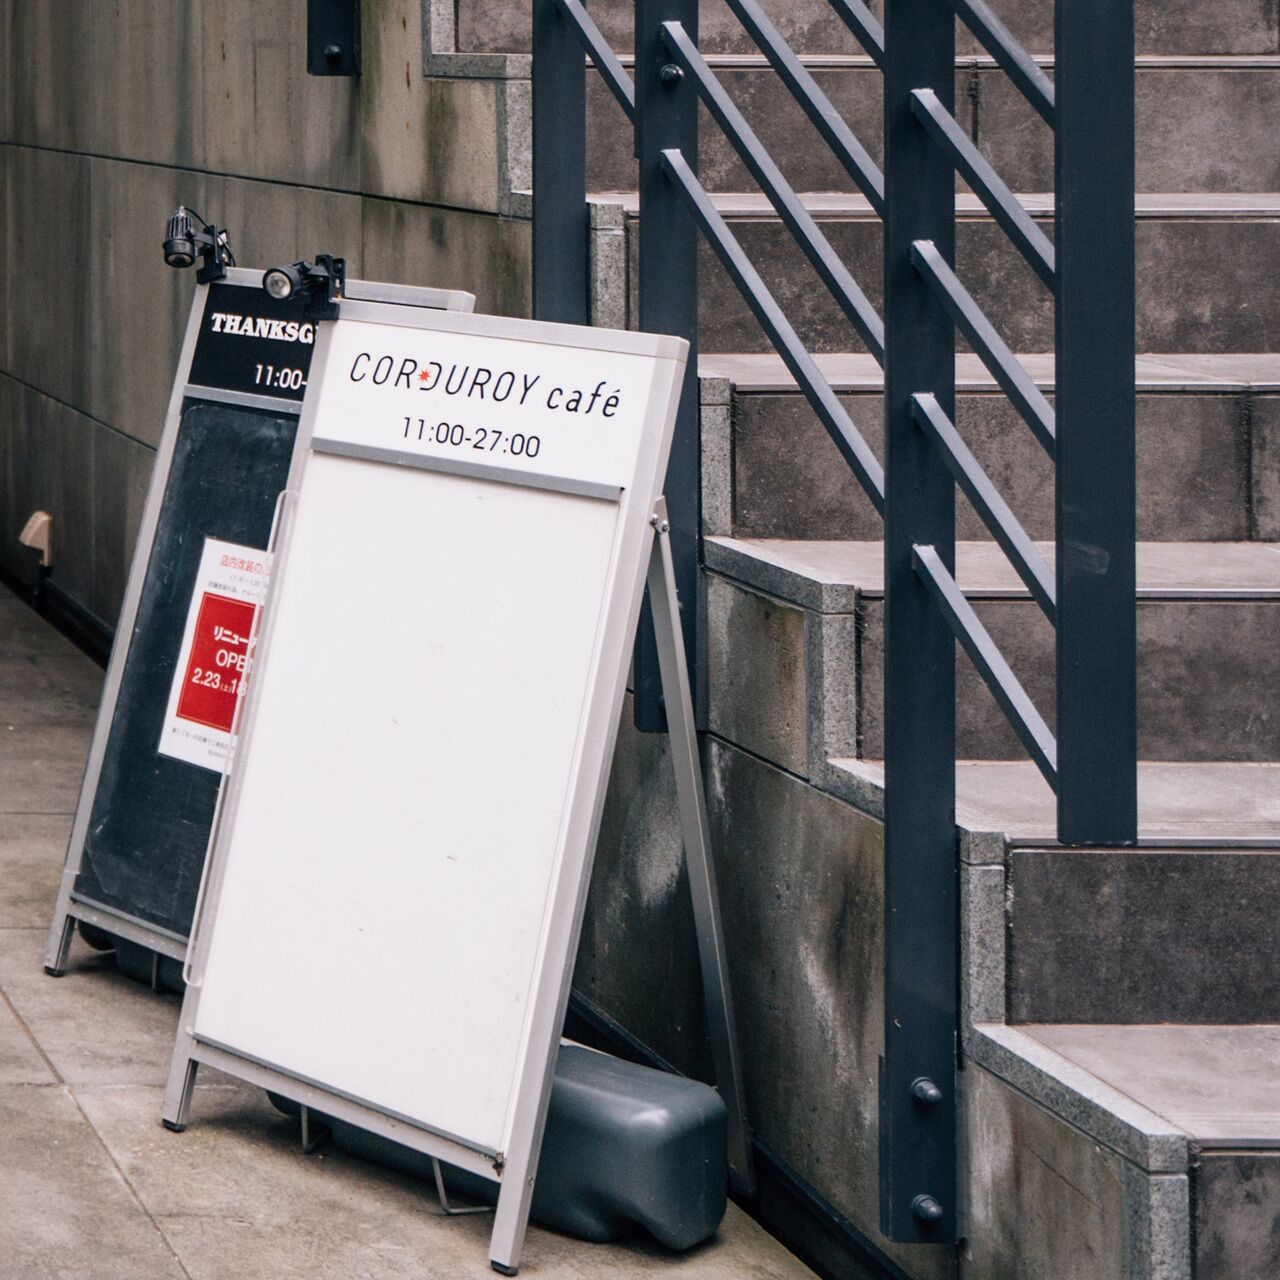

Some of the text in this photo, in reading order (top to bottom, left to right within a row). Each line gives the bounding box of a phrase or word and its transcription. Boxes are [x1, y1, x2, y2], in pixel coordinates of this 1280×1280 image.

[211, 312, 319, 344] THANKSG
[349, 352, 622, 418] CORDUROY café
[402, 416, 542, 458] 11:00-27:00
